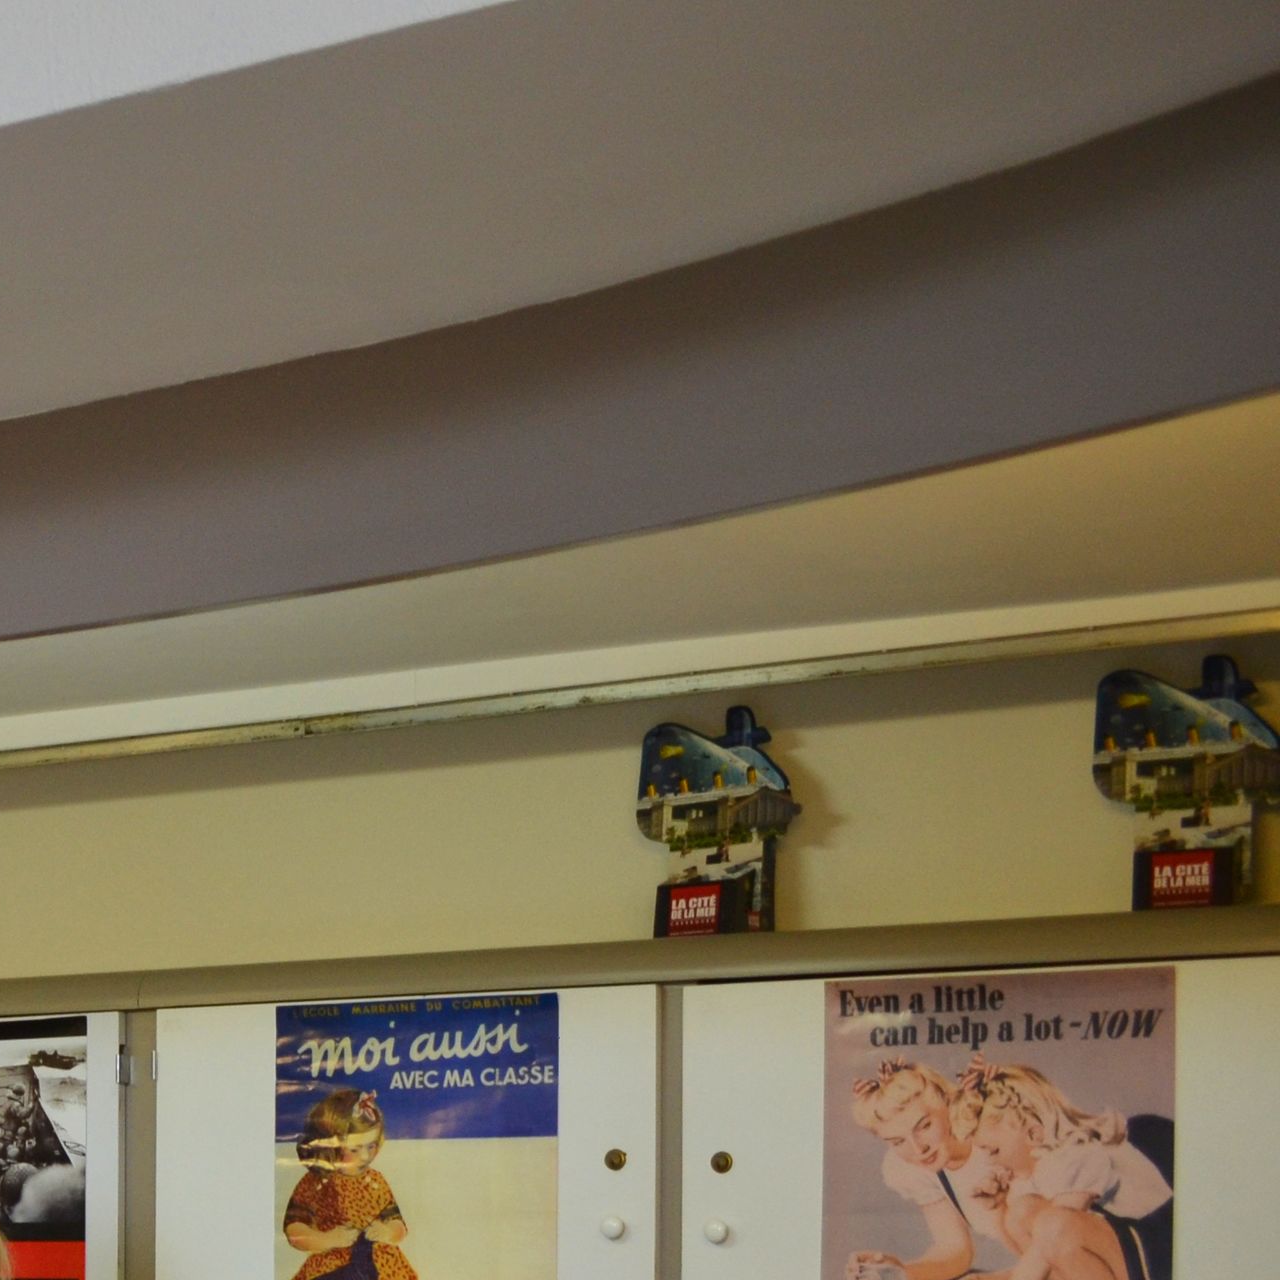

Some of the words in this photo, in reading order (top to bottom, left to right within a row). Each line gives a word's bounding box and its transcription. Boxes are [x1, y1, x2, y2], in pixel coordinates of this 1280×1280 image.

[671, 899, 686, 909] LA
[839, 988, 900, 1017] Even
[909, 996, 924, 1013] a
[934, 984, 1005, 1012] little
[409, 1009, 529, 1062] aussi
[870, 1026, 918, 1047] can
[927, 1017, 988, 1050] help
[998, 1024, 1014, 1042] a
[1024, 1013, 1063, 1041] lot
[390, 1070, 439, 1089] AVEC
[443, 1069, 474, 1087] MA
[480, 1065, 554, 1086] CLASSE
